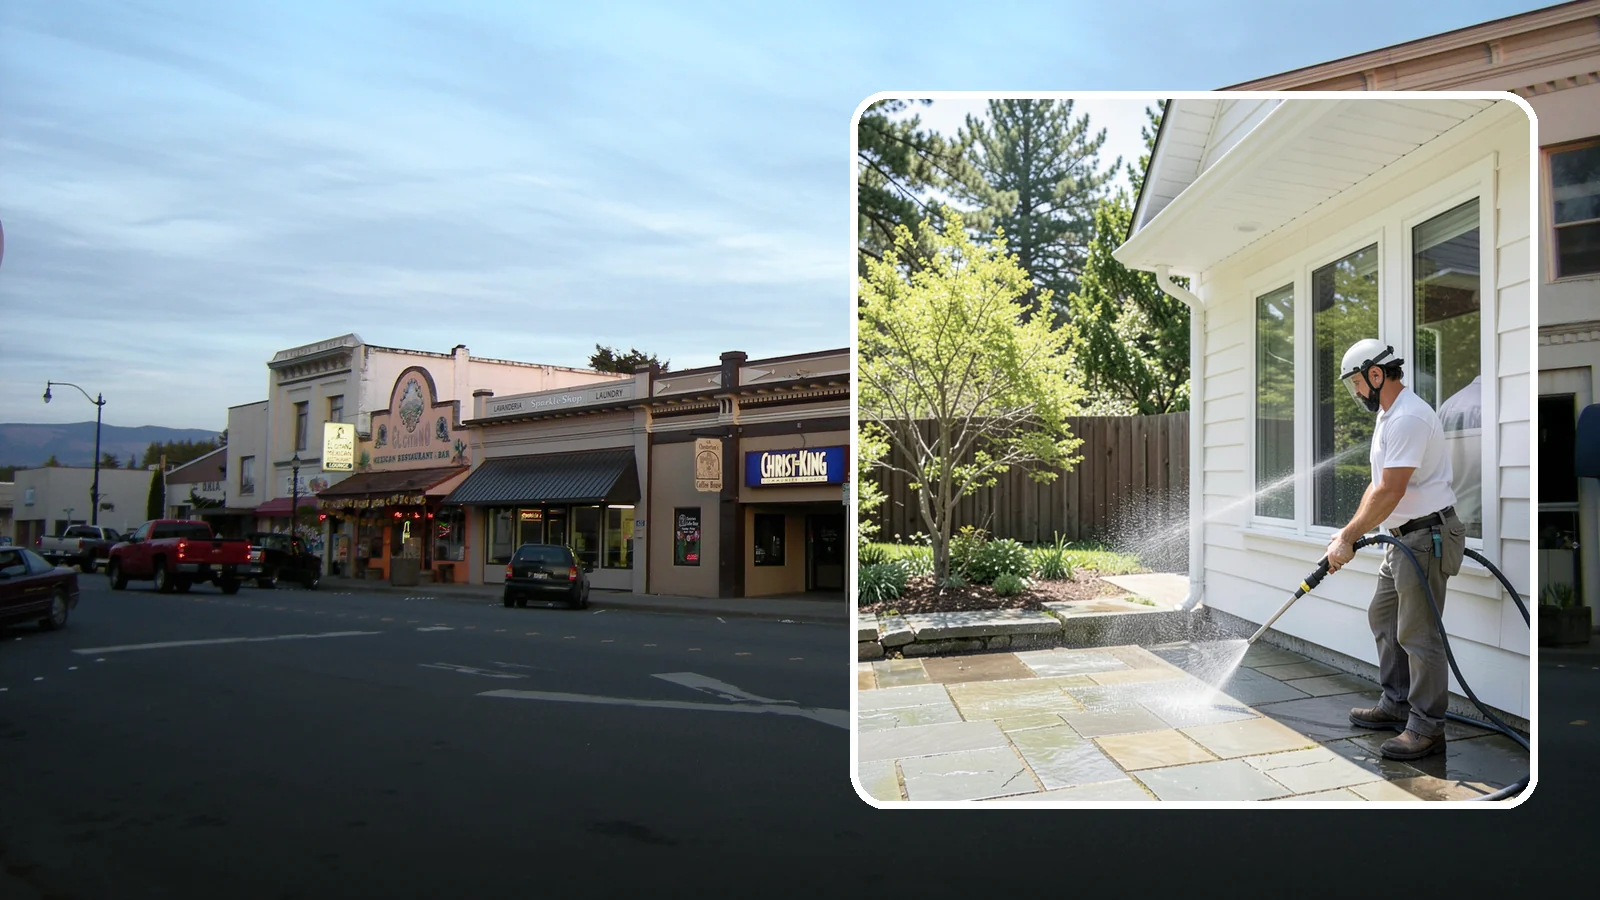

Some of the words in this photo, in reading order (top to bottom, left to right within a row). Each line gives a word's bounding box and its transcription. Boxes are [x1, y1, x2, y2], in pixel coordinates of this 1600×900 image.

[595, 389, 624, 400] LAUNDRY
[493, 402, 522, 412] LAVANDERIA
[531, 397, 560, 409] Sparkle
[561, 394, 582, 406] Shop
[397, 452, 433, 462] RESTAURANT
[438, 450, 450, 458] BAR
[761, 452, 797, 478] CHRIST
[799, 450, 828, 476] KING
